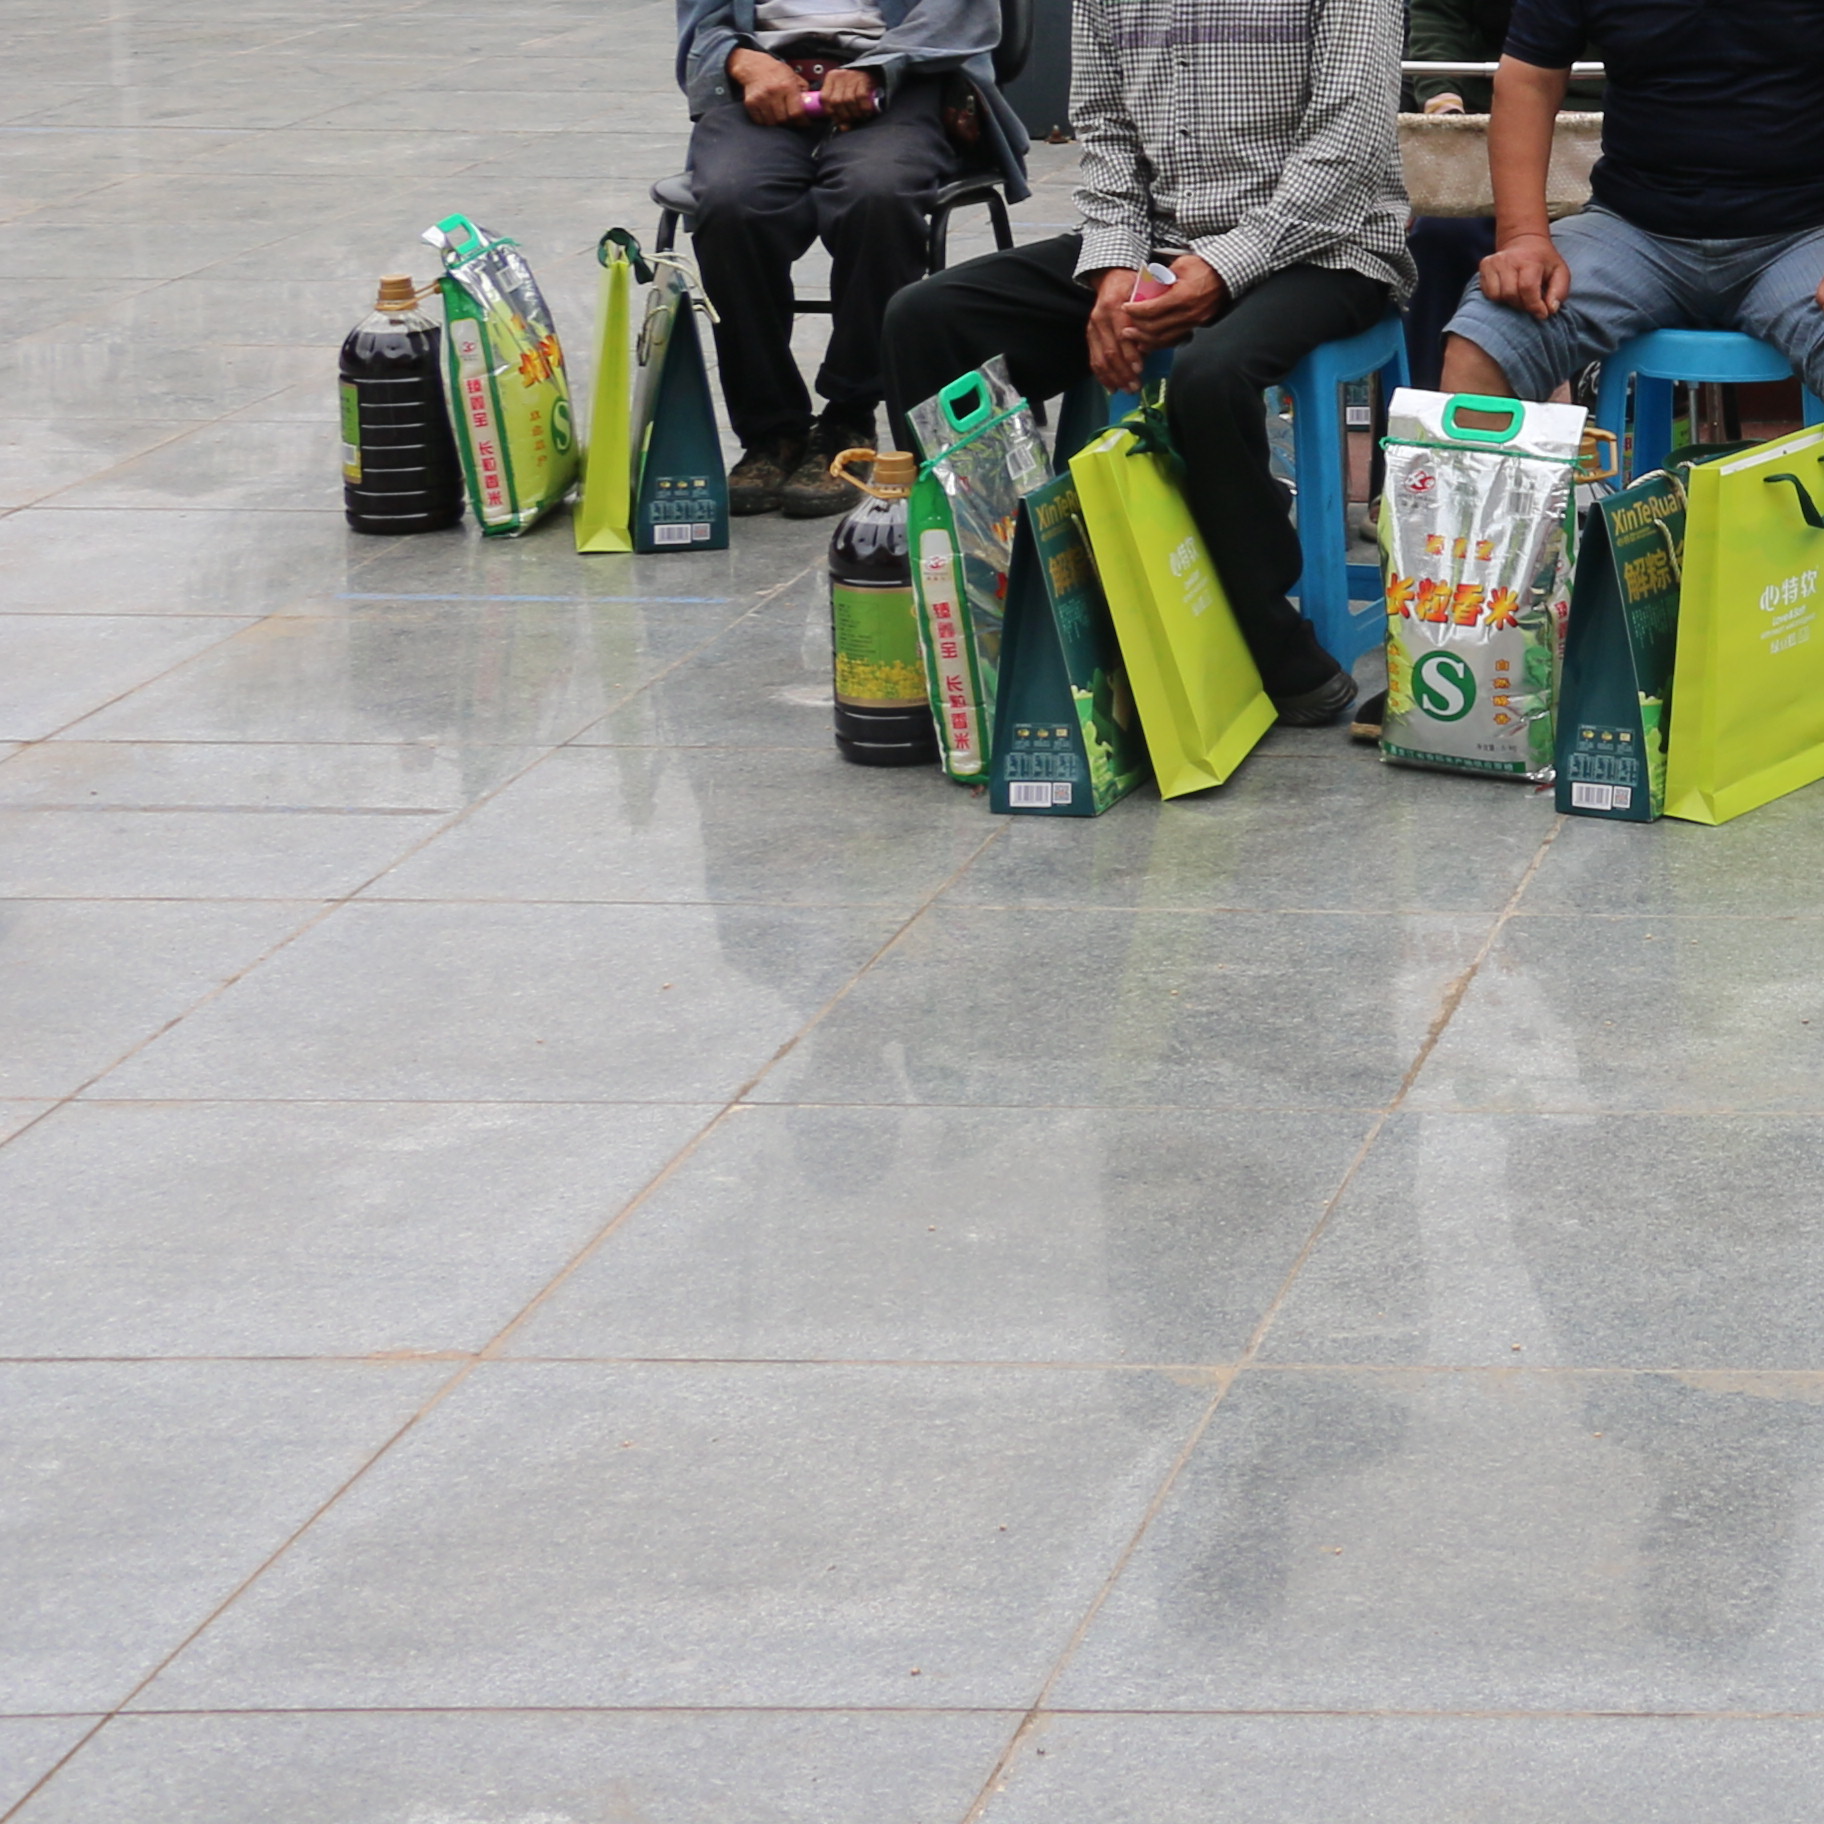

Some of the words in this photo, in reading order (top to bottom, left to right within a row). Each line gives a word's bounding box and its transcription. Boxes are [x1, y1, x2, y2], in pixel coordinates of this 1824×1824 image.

[1386, 572, 1519, 631] 长粒香米
[1759, 568, 1819, 612] 心特软
[946, 675, 971, 750] 长粒香米
